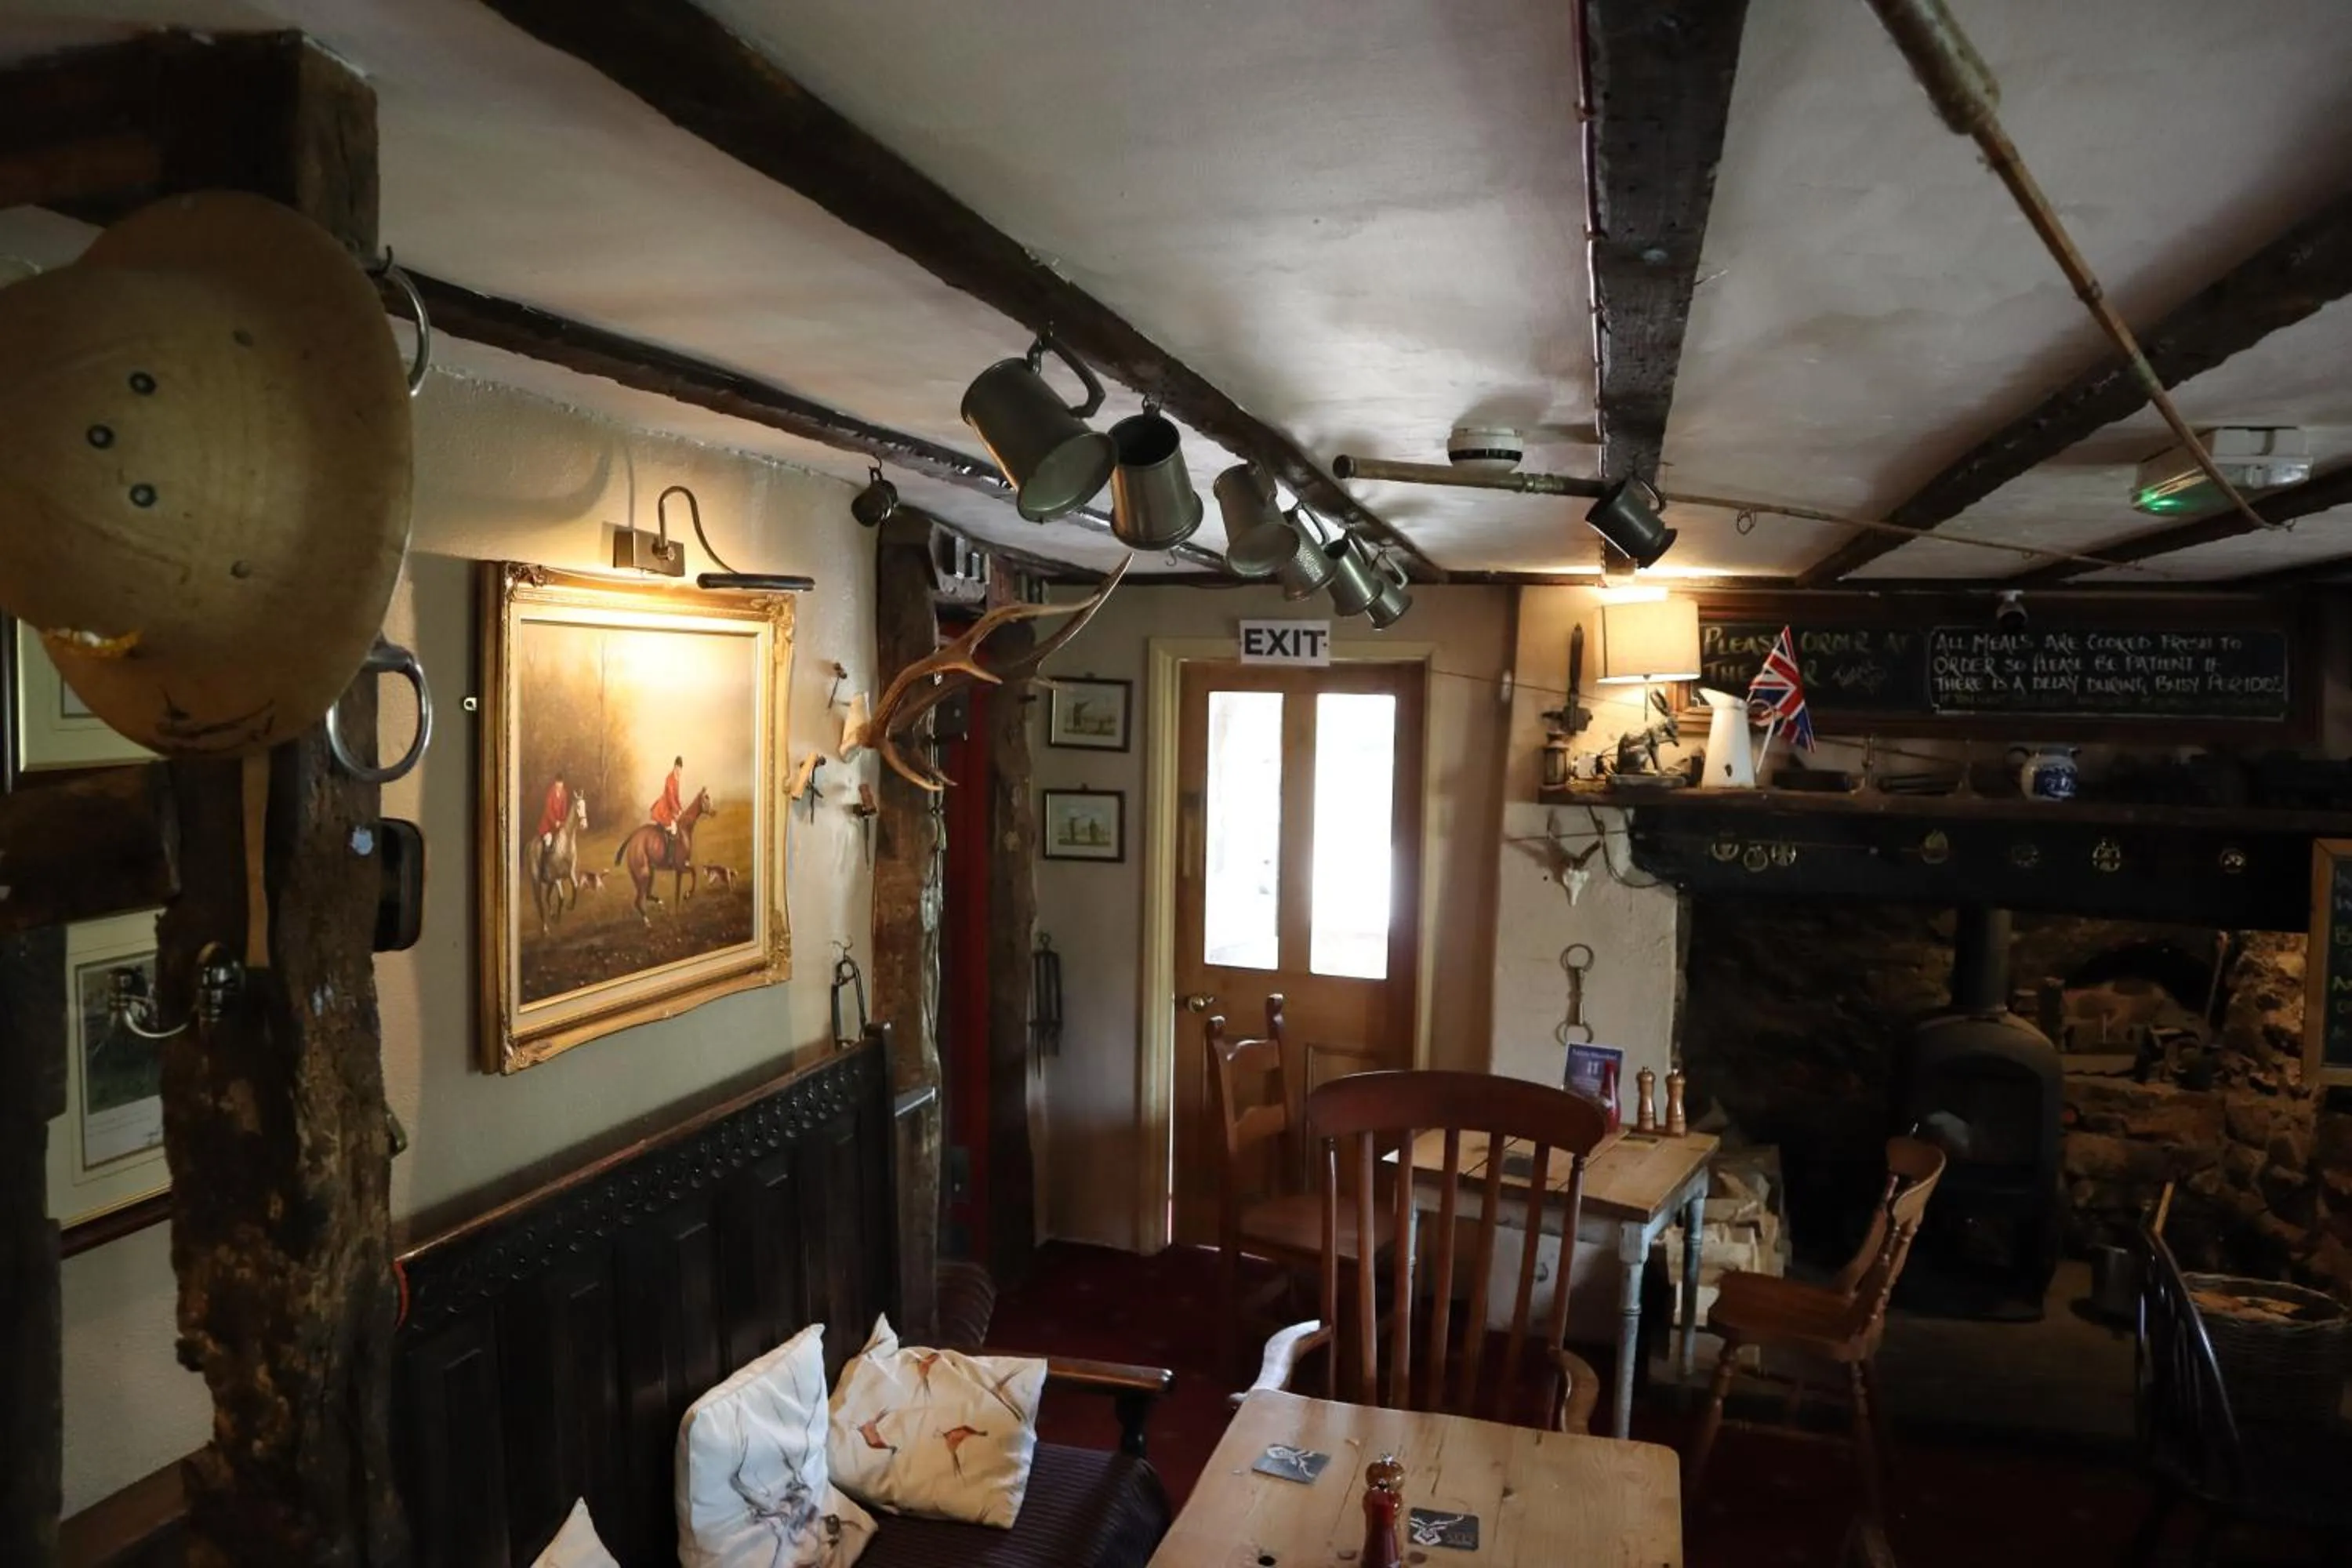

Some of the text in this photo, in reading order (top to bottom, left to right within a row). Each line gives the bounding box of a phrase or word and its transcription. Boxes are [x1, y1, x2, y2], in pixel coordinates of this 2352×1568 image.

[1244, 628, 1327, 658] EXIT
[1704, 627, 1778, 655] PLEAS
[1936, 633, 1964, 656] ALL
[1972, 633, 2034, 655] MEALS
[2045, 633, 2082, 655] ARE
[2087, 633, 2152, 655] COOKED
[2220, 636, 2243, 652] TO
[1704, 660, 1750, 683] THE
[1933, 655, 1999, 679] ORDER
[2004, 658, 2027, 674] SO
[2094, 653, 2119, 673] BE
[2125, 655, 2194, 674] PATIENT
[1932, 676, 1983, 692] THERE
[1992, 677, 2009, 691] IS
[2013, 675, 2027, 695] A
[2032, 674, 2079, 696] DELAY
[2087, 677, 2149, 695] DURING
[2155, 675, 2200, 694] BUSY
